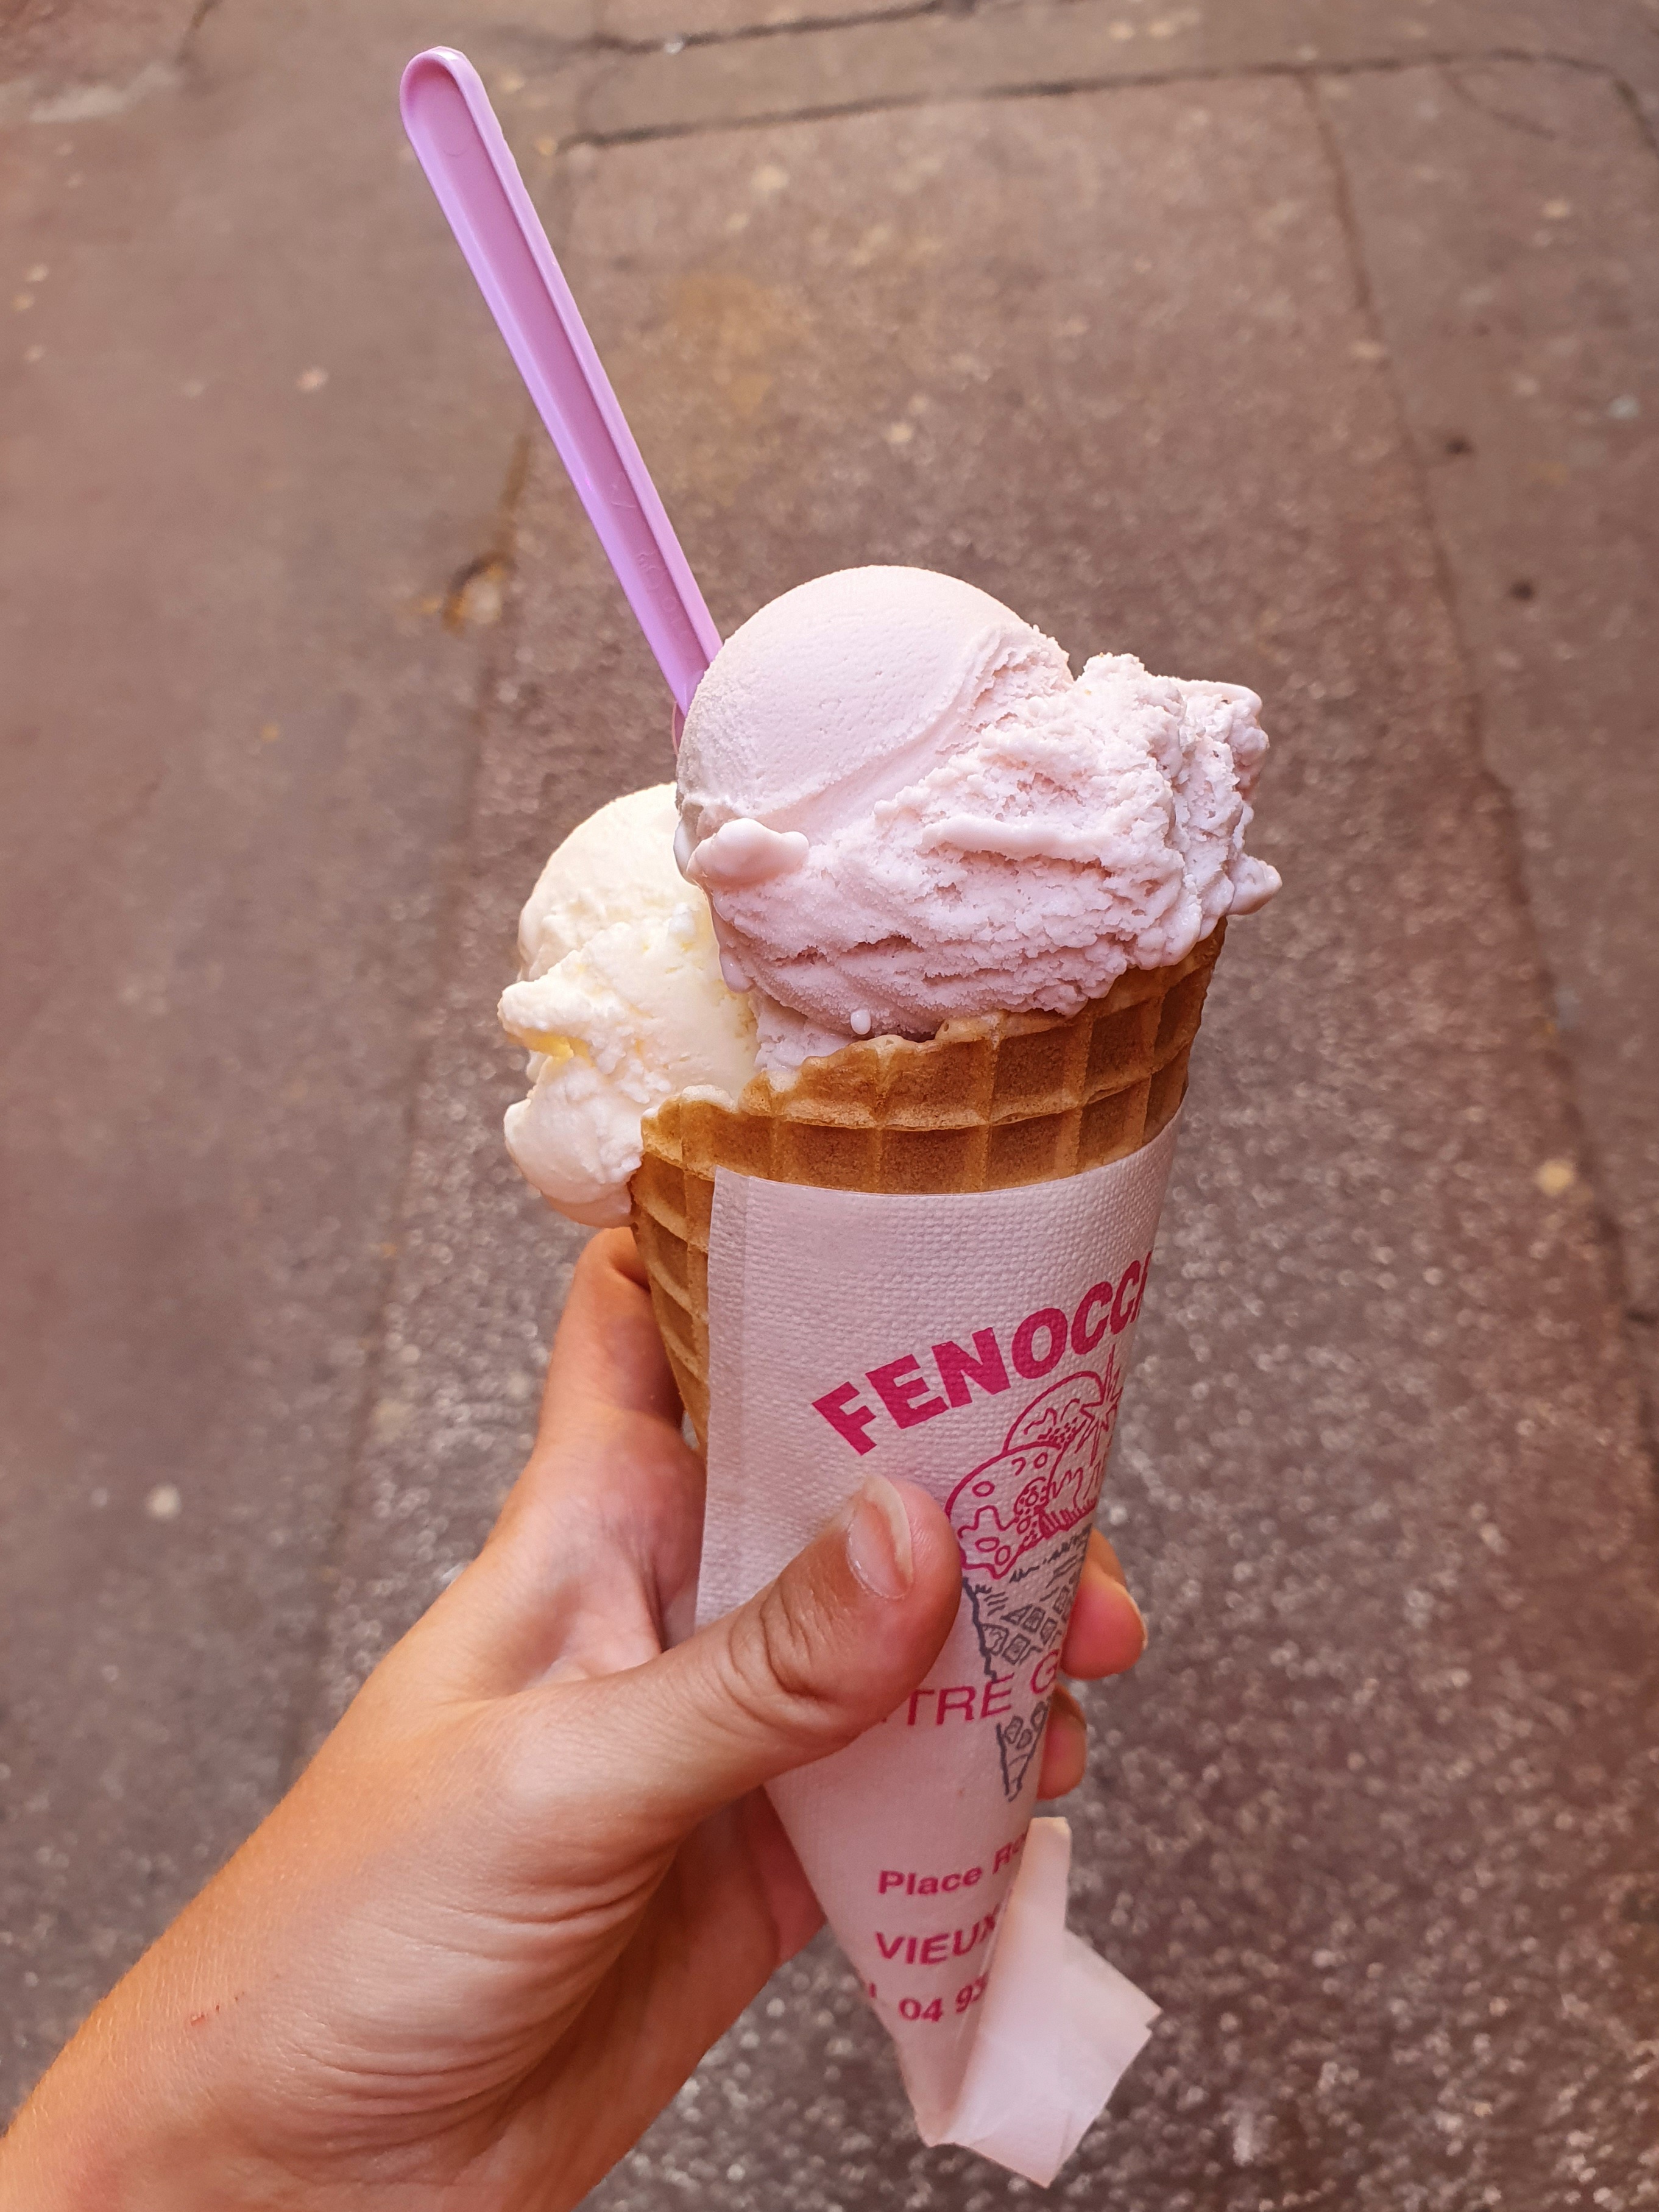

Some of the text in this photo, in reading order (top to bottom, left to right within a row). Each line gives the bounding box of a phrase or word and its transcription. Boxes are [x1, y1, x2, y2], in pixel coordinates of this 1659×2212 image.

[812, 1251, 1151, 1455] FENOCC
[882, 1648, 1059, 1725] TRE G
[879, 1867, 982, 1895] Place
[899, 1998, 943, 2022] 04
